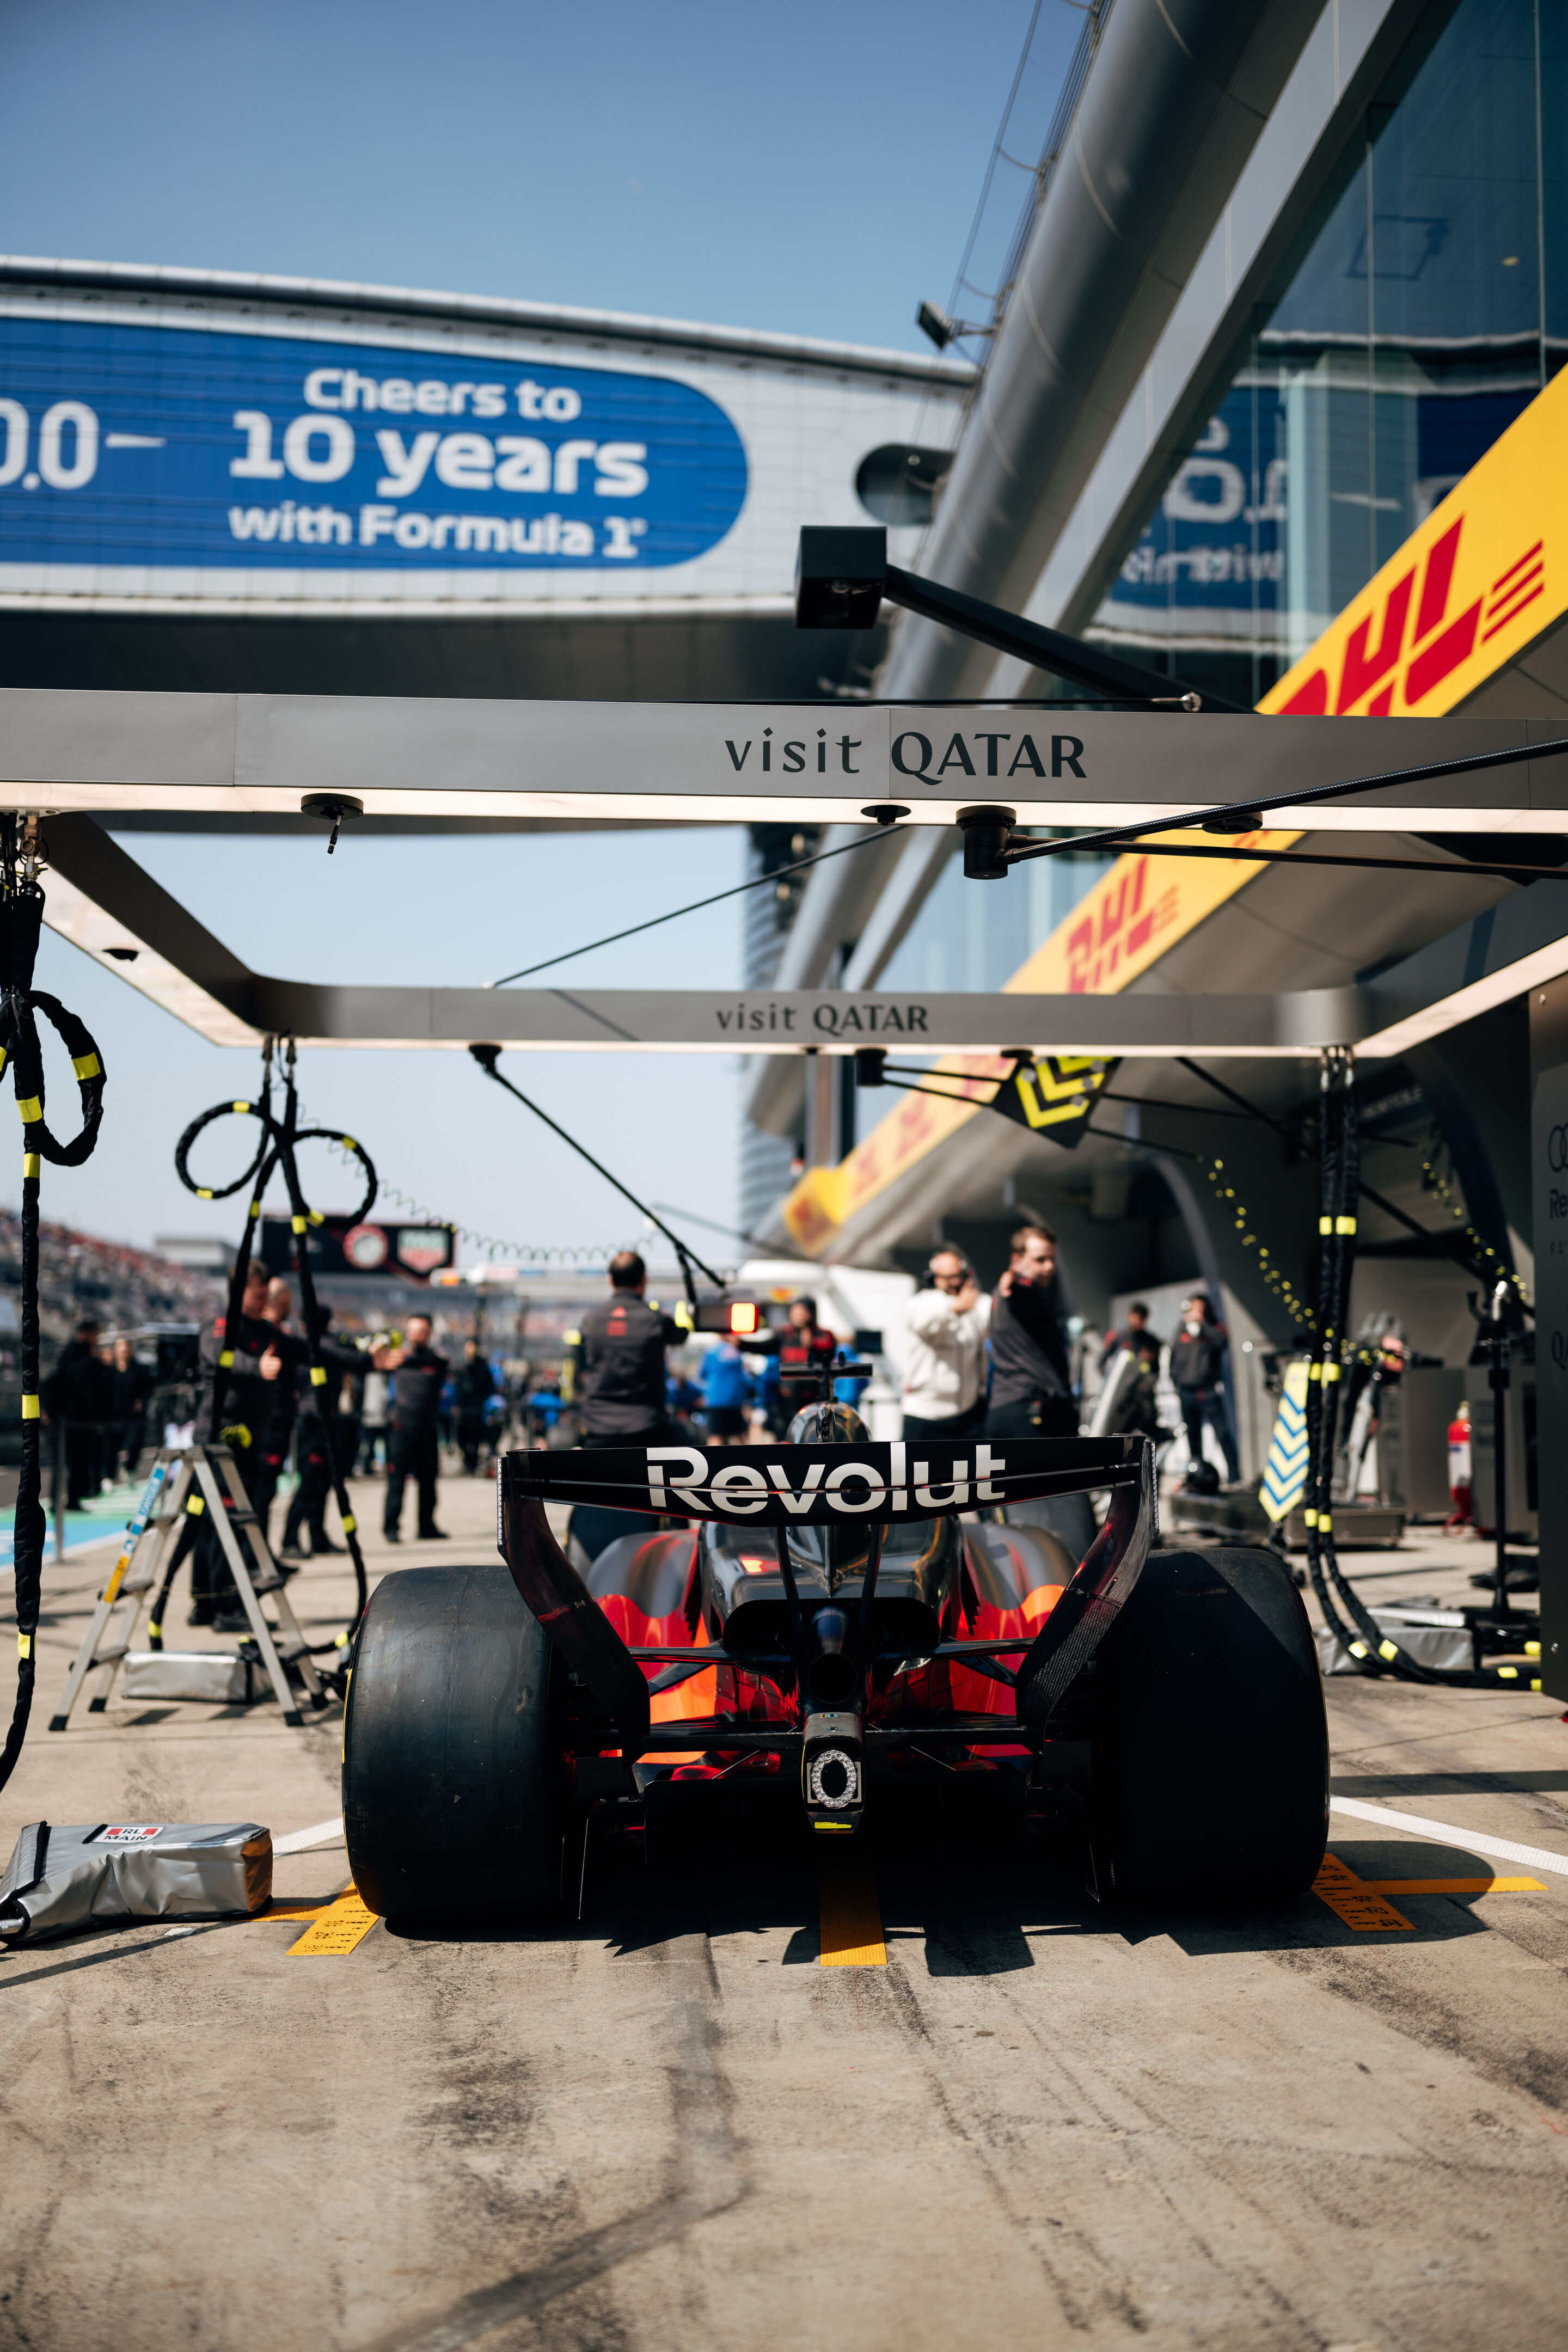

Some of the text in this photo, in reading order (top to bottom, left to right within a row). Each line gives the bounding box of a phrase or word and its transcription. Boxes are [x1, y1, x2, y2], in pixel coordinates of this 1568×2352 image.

[304, 367, 581, 423] Cheers to
[229, 410, 650, 498] 10 years
[228, 500, 353, 546] with
[360, 504, 594, 557] Formula
[724, 727, 1087, 786] visit QATAR
[716, 1002, 929, 1037] visit QATAR
[646, 1441, 1006, 1514] Revolut
